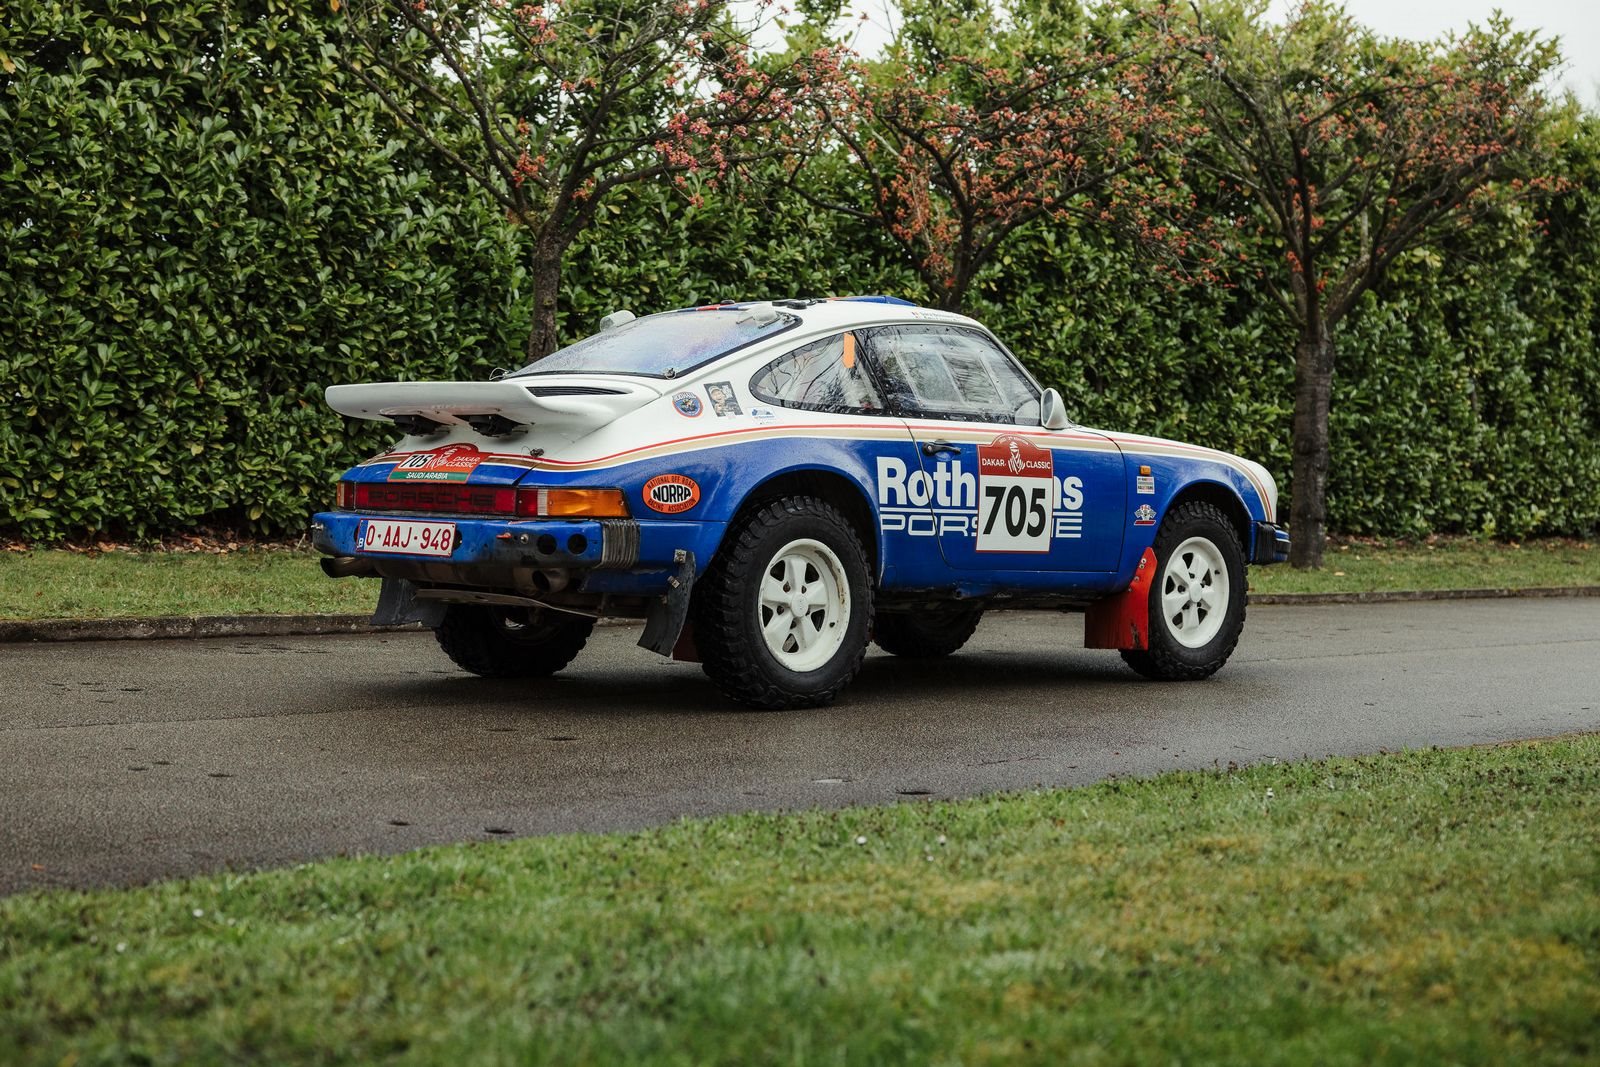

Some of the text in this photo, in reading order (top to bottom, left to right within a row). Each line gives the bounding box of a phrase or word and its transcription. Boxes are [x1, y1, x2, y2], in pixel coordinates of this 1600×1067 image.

[400, 455, 434, 467] 705
[981, 458, 1051, 469] DAKAR CLASSIC
[424, 472, 448, 480] ARABIA
[671, 475, 681, 483] OFF
[876, 456, 1084, 510] Roths
[368, 490, 496, 507] PORSCHE
[653, 484, 691, 503] NORRA
[982, 485, 1047, 538] 705
[358, 537, 364, 548] B
